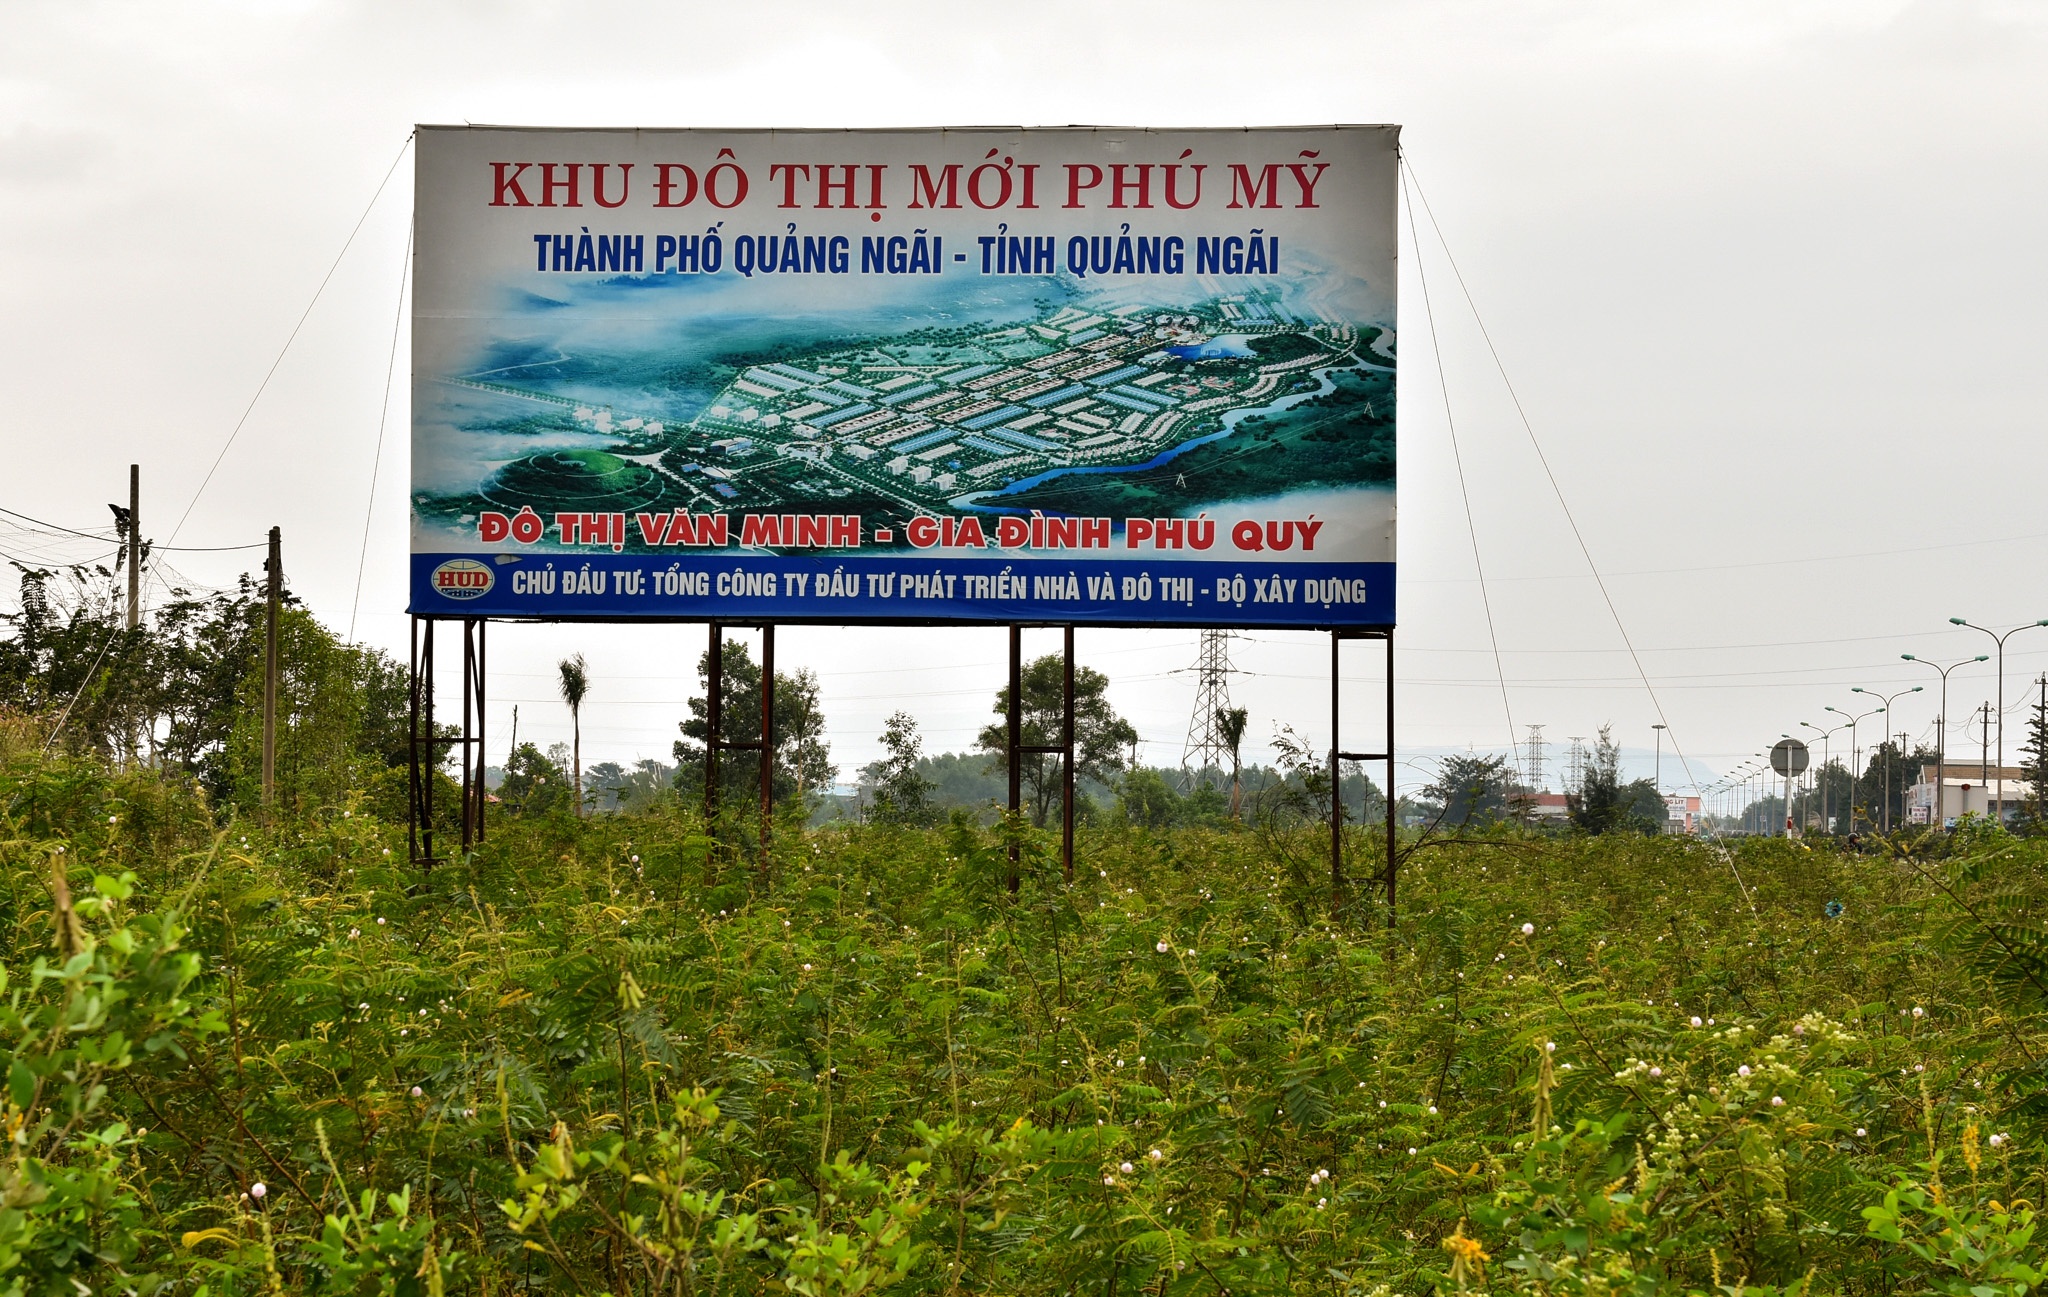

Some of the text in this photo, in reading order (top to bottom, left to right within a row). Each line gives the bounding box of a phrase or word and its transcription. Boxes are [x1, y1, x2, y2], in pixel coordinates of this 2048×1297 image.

[488, 148, 1330, 223] KHU ĐÔ THỊ MỚI PHÚ MỸ
[533, 227, 644, 272] THÀNH
[655, 222, 724, 273] PHỐ
[734, 222, 849, 277] QUẢNG
[861, 229, 942, 274] NGÃI
[978, 223, 1055, 274] TỈNH
[1067, 223, 1184, 279] QUẢNG
[1196, 228, 1279, 275] NGÃI
[479, 506, 543, 544] ĐÔ
[555, 513, 625, 552] THỊ
[637, 507, 728, 546] VĂN
[741, 515, 860, 547] MINH
[907, 516, 986, 548] GIA
[996, 509, 1110, 549] ĐÌNH
[1126, 512, 1216, 550] PHÚ
[1231, 513, 1324, 553] QUÝ
[437, 571, 489, 587] HUD
[512, 562, 556, 595] CHỦ
[562, 562, 606, 595] ĐẦU
[612, 569, 646, 595] TƯ:
[652, 562, 710, 596] TỔNG
[716, 567, 777, 597] CÔNG
[784, 573, 808, 597] TY
[814, 565, 860, 598] ĐẦU
[866, 571, 894, 599] TƯ
[900, 569, 957, 599] PHÁT
[963, 565, 1027, 600] TRIỂN
[1034, 571, 1080, 601] NHÀ
[1086, 571, 1115, 601] VÀ
[1121, 571, 1152, 601] ĐÔ
[1159, 577, 1194, 607] THỊ
[1216, 573, 1247, 608] BỘ
[1253, 573, 1297, 604] XÂY
[1304, 576, 1367, 609] DỰNG
